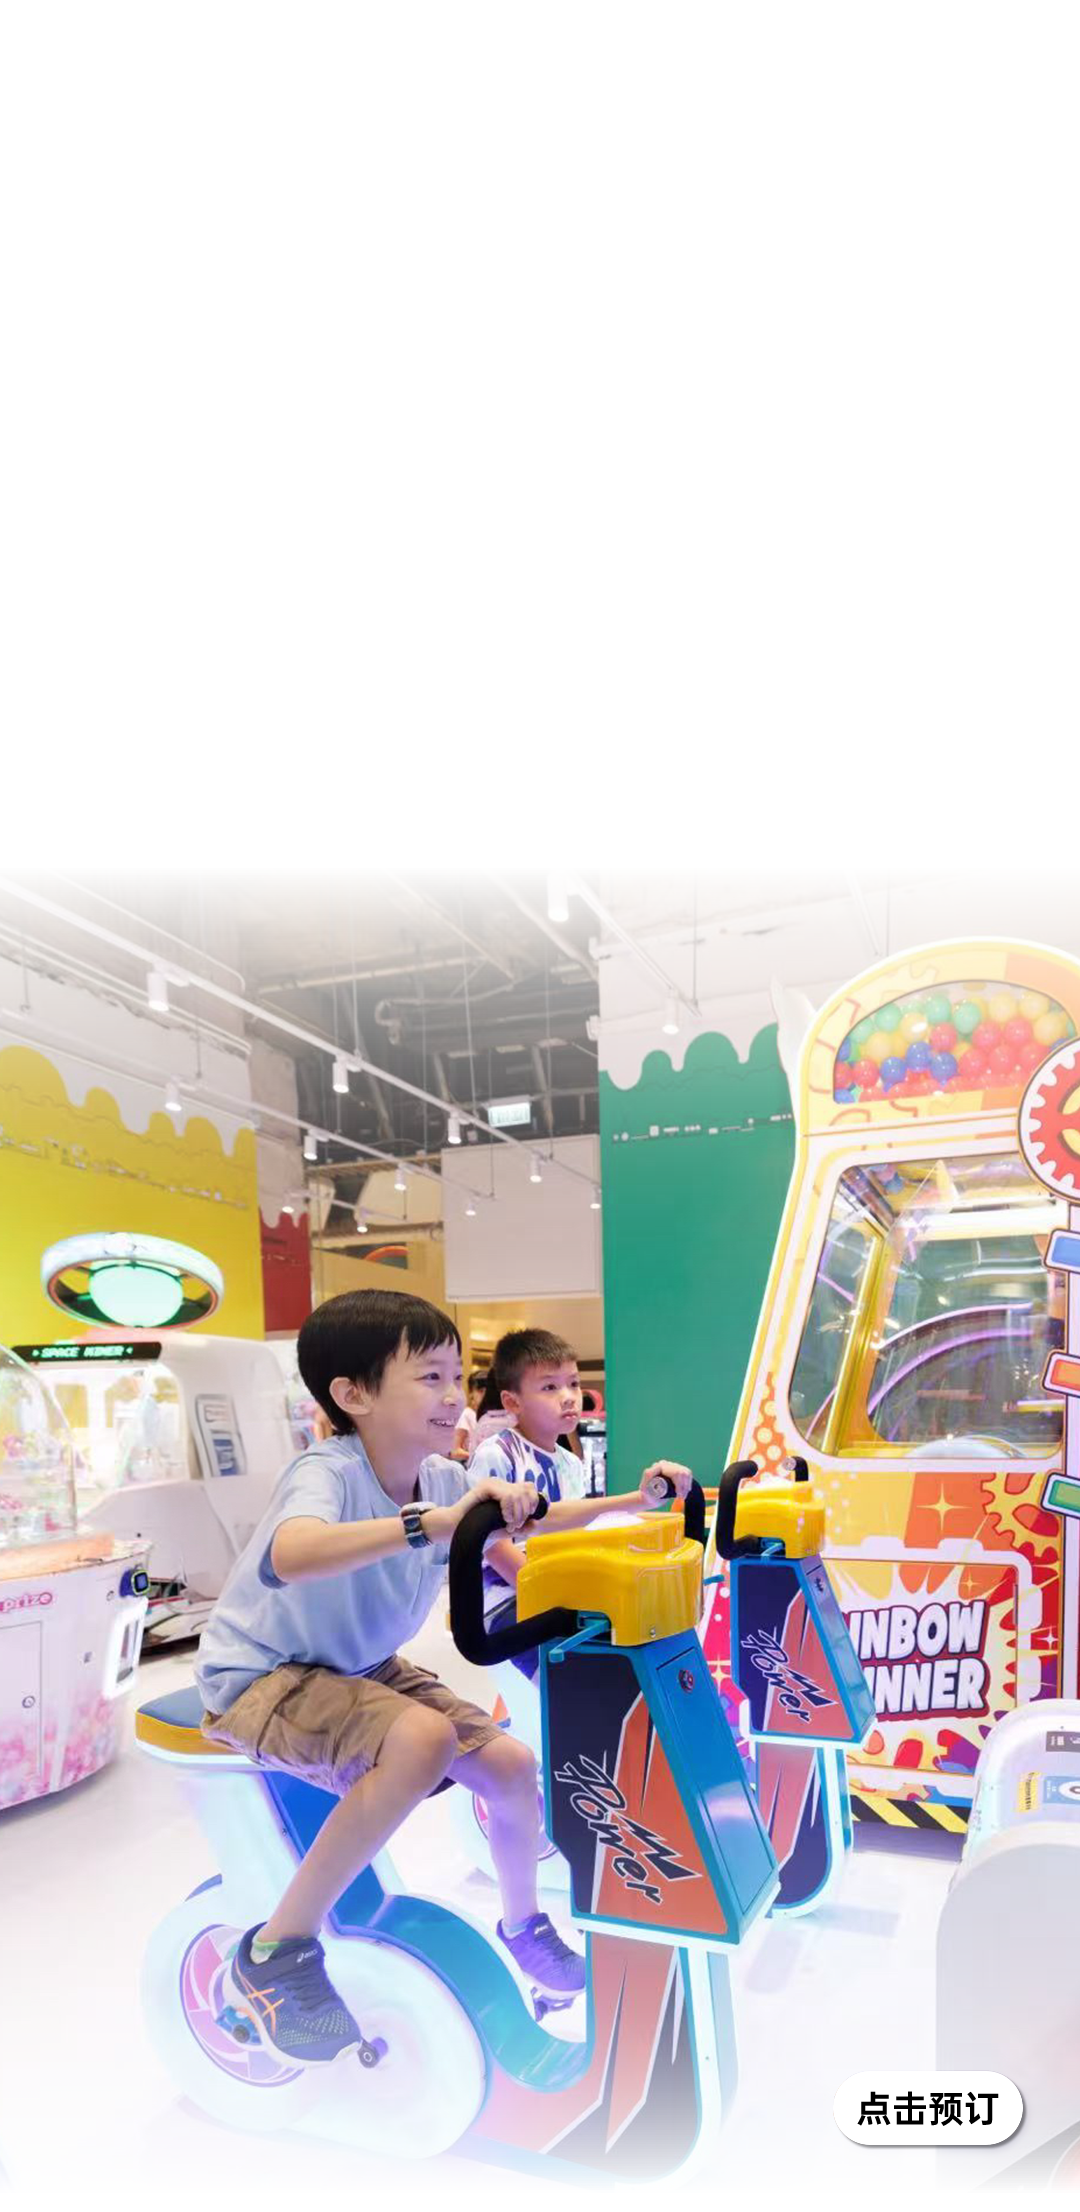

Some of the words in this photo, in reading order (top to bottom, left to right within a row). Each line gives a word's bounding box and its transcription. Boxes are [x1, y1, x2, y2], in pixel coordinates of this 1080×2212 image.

[41, 1347, 79, 1358] SPACE
[848, 1600, 986, 1661] INBOW
[862, 1657, 986, 1715] INNER
[553, 1749, 664, 1904] Power
